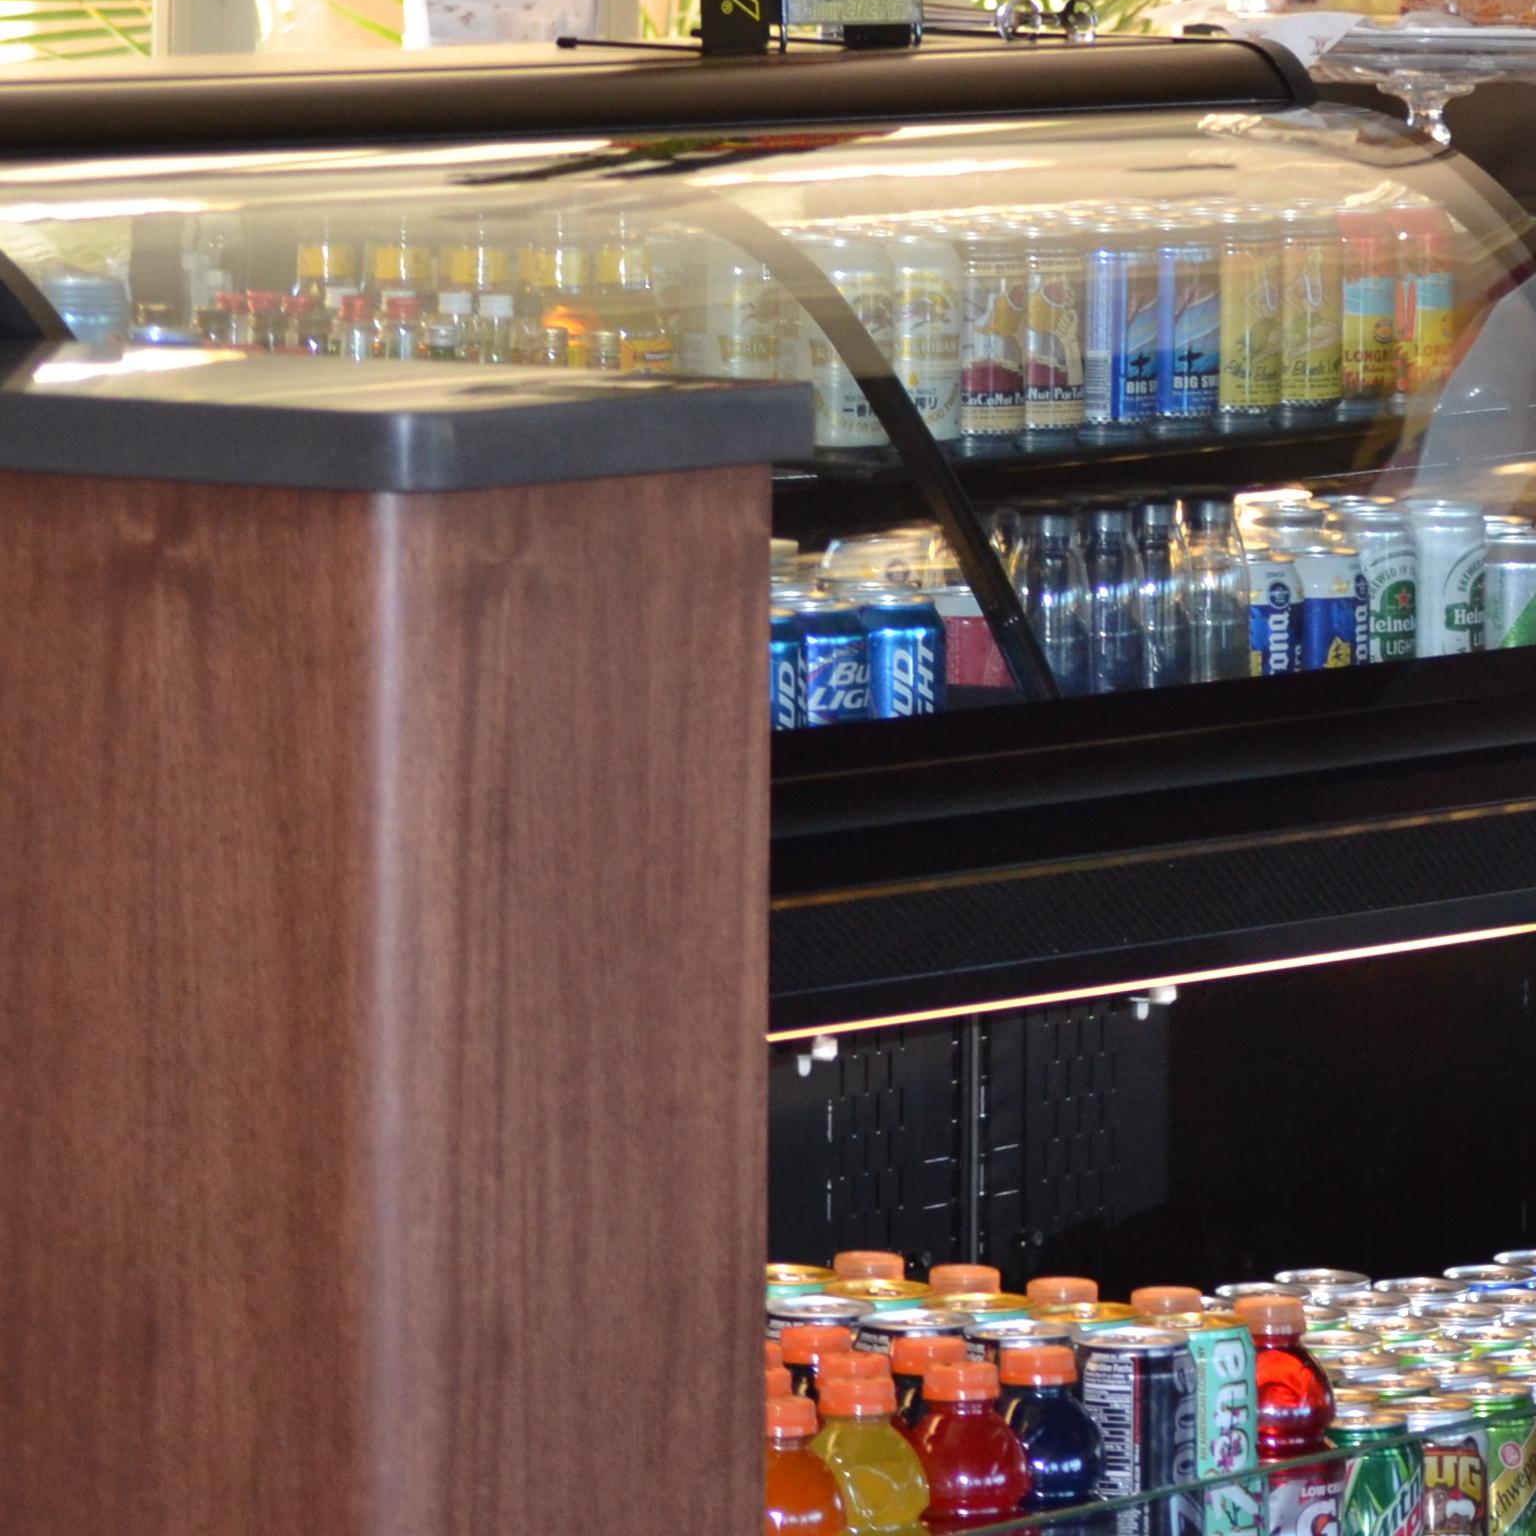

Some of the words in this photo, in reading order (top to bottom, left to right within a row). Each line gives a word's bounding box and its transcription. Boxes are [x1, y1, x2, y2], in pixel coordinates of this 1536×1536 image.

[1173, 375, 1199, 390] BIG
[777, 661, 796, 730] UD
[892, 649, 913, 718] UD
[1301, 1486, 1325, 1498] LOW
[1425, 1455, 1482, 1504] UG
